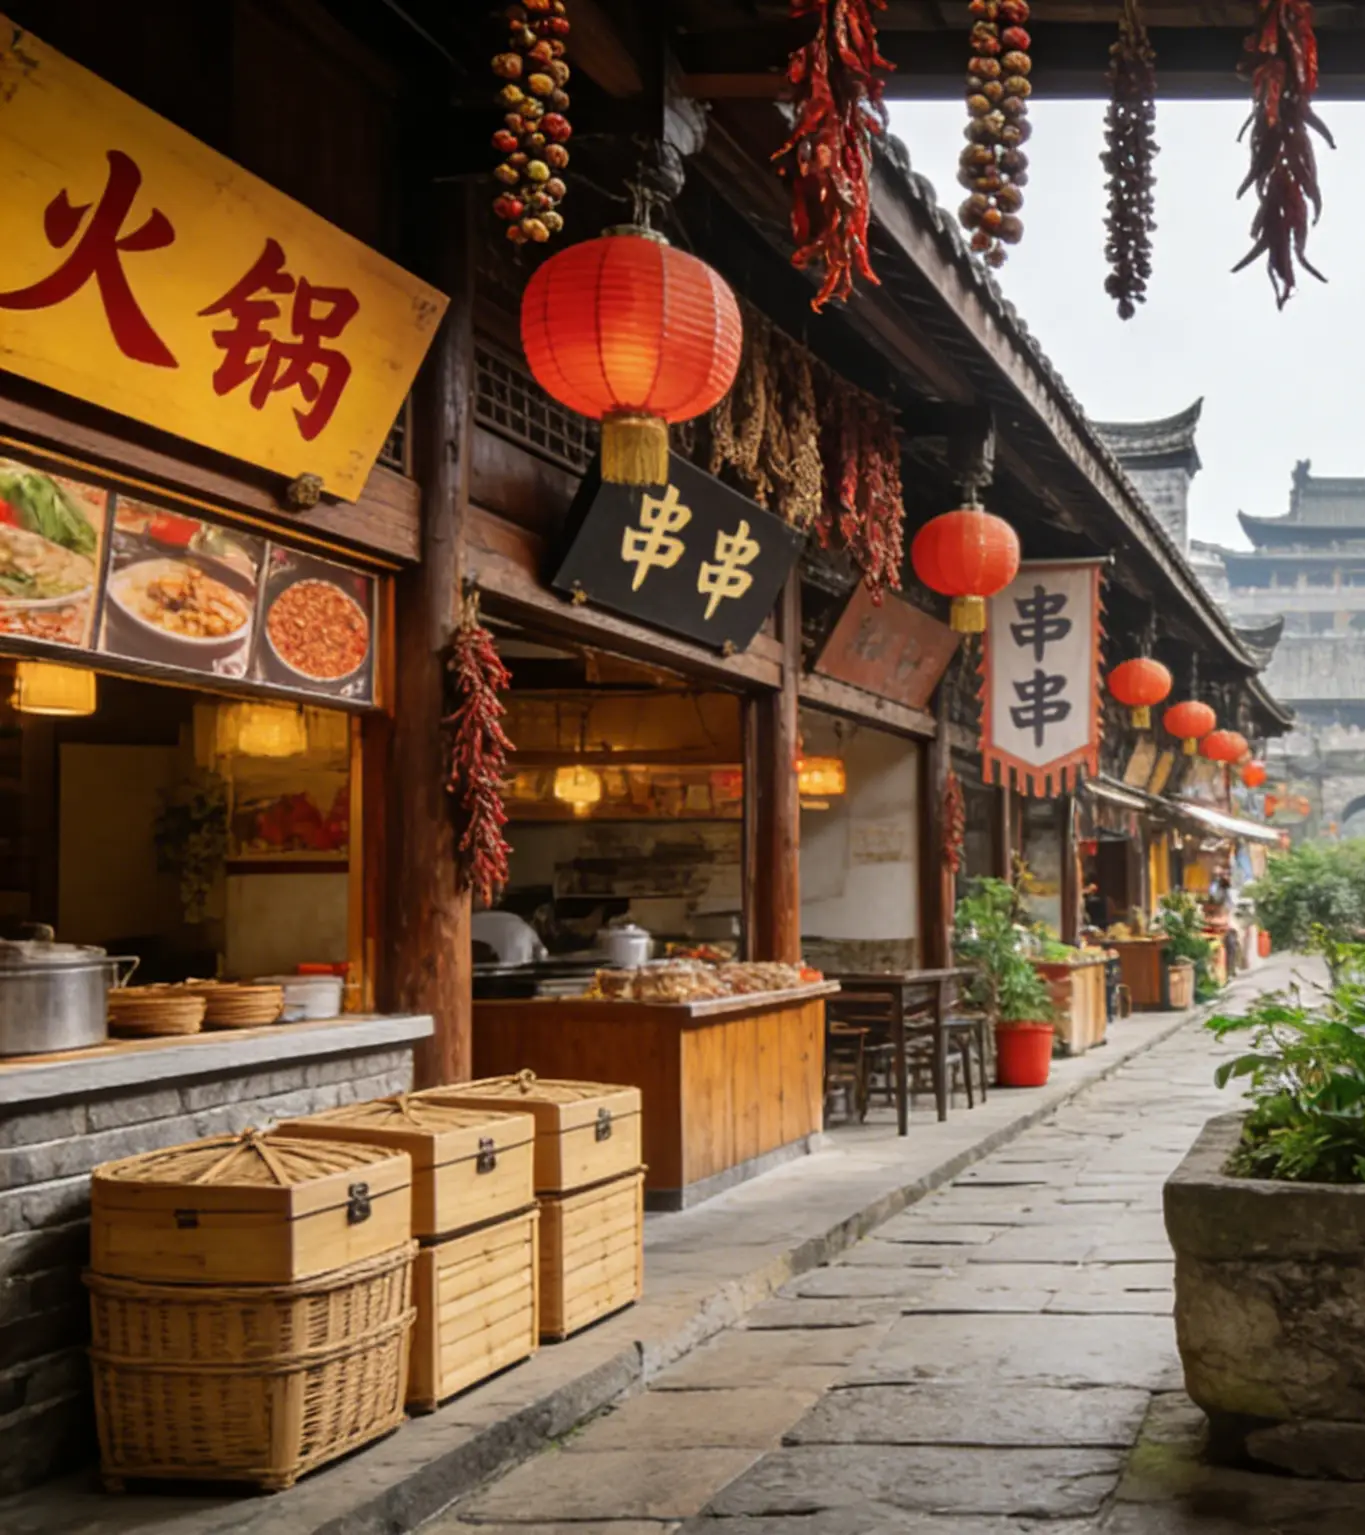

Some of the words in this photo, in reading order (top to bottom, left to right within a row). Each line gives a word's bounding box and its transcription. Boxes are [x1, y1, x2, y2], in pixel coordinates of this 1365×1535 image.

[0, 149, 361, 442] 火锅
[621, 485, 762, 621] 串串
[1009, 585, 1073, 748] 串串
